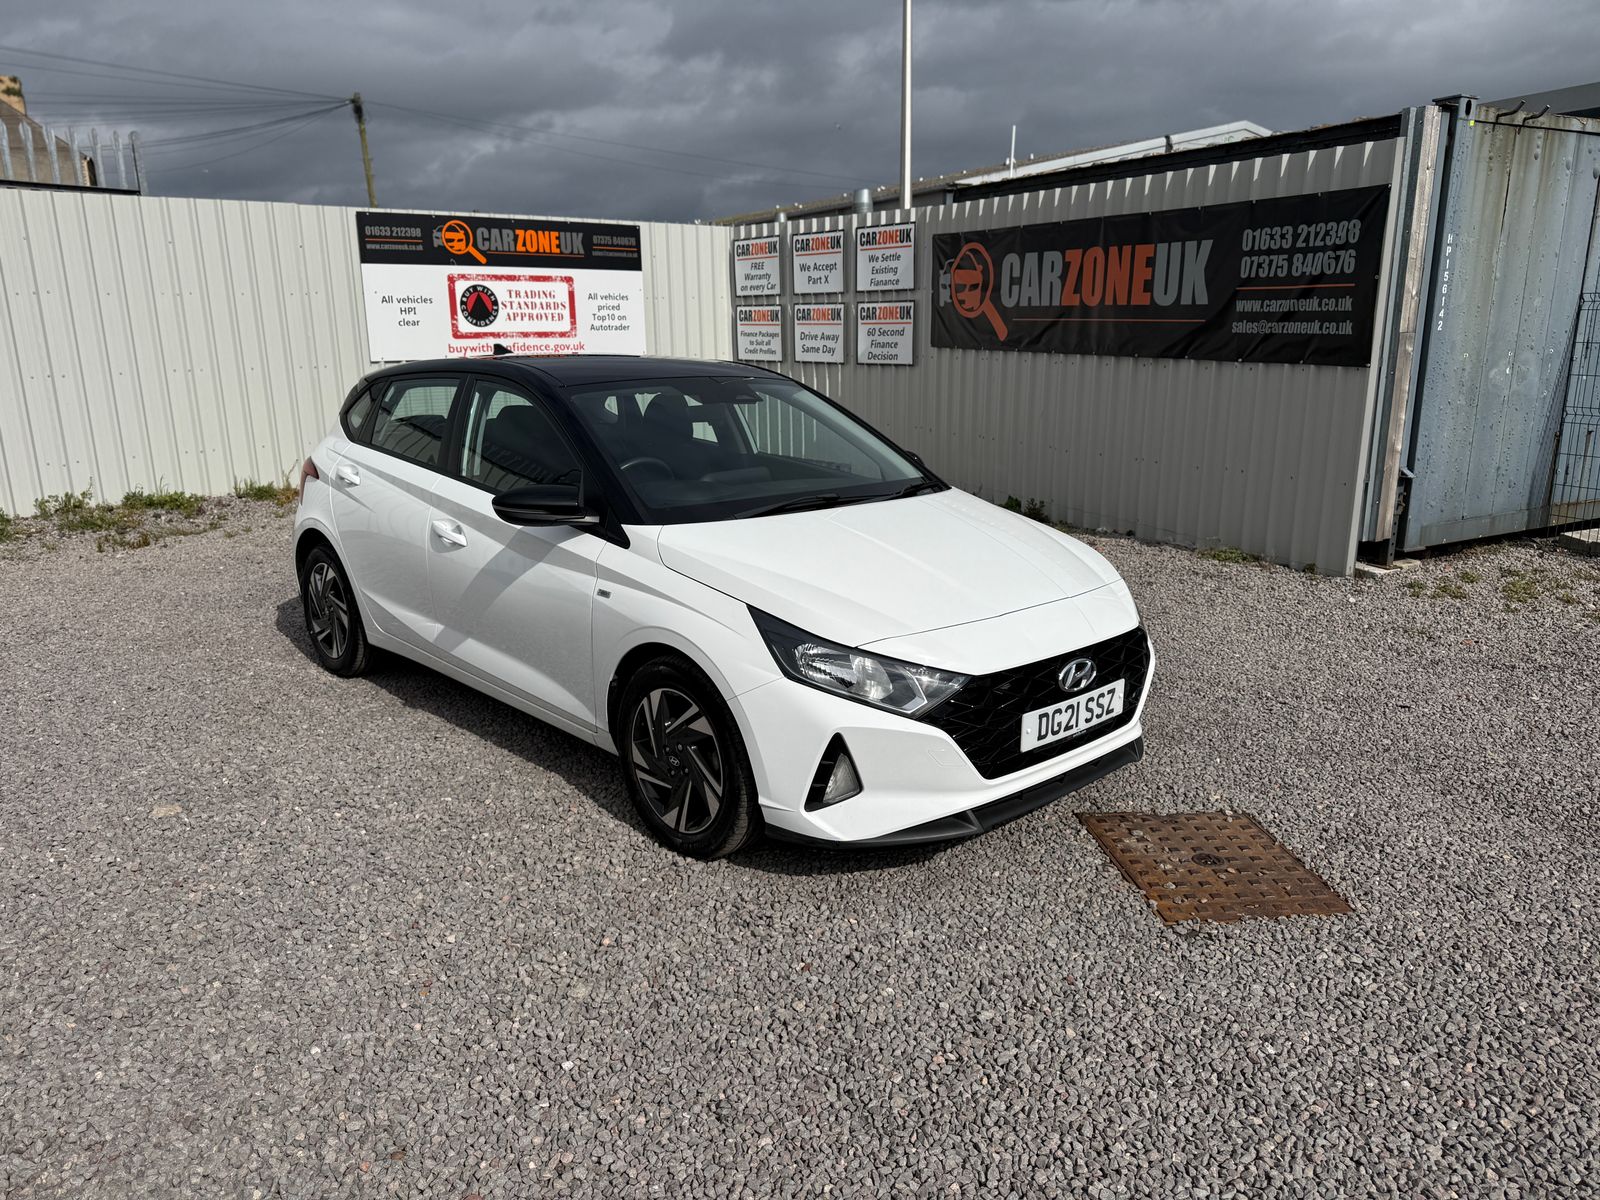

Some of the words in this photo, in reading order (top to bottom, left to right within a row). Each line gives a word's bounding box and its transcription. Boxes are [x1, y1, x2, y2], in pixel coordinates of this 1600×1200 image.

[365, 225, 390, 236] 01633
[391, 226, 421, 237] 212398
[1242, 225, 1294, 252] 01633
[1296, 219, 1361, 248] 212398
[476, 227, 585, 254] CARZONEUK
[860, 228, 912, 247] CARZONEUK
[736, 241, 778, 257] CARZONEUK
[795, 235, 842, 252] CARZONEUK
[868, 254, 879, 263] We
[881, 252, 902, 262] Settle
[750, 262, 765, 270] FREE
[799, 263, 811, 272] We
[813, 262, 837, 273] Accept
[1240, 254, 1289, 279] 07375
[1291, 249, 1357, 277] 840676
[871, 265, 898, 276] Existing
[1000, 239, 1214, 308] CARZONEUK
[744, 272, 771, 281] Warranty
[807, 276, 822, 285] Part
[824, 275, 829, 284] X
[462, 287, 474, 301] BUY
[476, 285, 495, 301] WITH
[750, 284, 765, 293] every
[766, 282, 777, 290] Car
[381, 295, 393, 304] All
[396, 295, 433, 304] vehicles
[507, 289, 556, 299] TRADING
[588, 292, 598, 300] All
[600, 292, 629, 301] vehicles
[501, 300, 567, 310] STANDARDS
[597, 303, 621, 312] priced
[1236, 296, 1353, 313] www.carzoneuk.co.uk
[400, 306, 417, 315] HPI
[461, 304, 498, 326] CONFIDENCE
[739, 309, 780, 322] CARZONEUK
[796, 308, 842, 321] CARZONEUK
[860, 305, 912, 321] CARZONEUK
[398, 318, 420, 326] clear
[505, 312, 565, 322] APPROVED
[592, 313, 616, 323] Top10
[590, 323, 630, 331] Autotrader
[867, 327, 877, 337] 60
[877, 326, 906, 337] Second
[1232, 320, 1353, 335] sales@carzoneuk.co.uk
[759, 331, 780, 339] Packages
[800, 331, 819, 341] Drive
[820, 332, 840, 344] Away
[448, 341, 585, 358] buywithnfidence.gov.uk
[870, 339, 899, 349] Finance
[801, 344, 821, 354] Same
[822, 345, 836, 357] Day
[867, 351, 899, 361] Decision
[1036, 701, 1080, 742] DG21
[1084, 687, 1117, 725] SSZ
